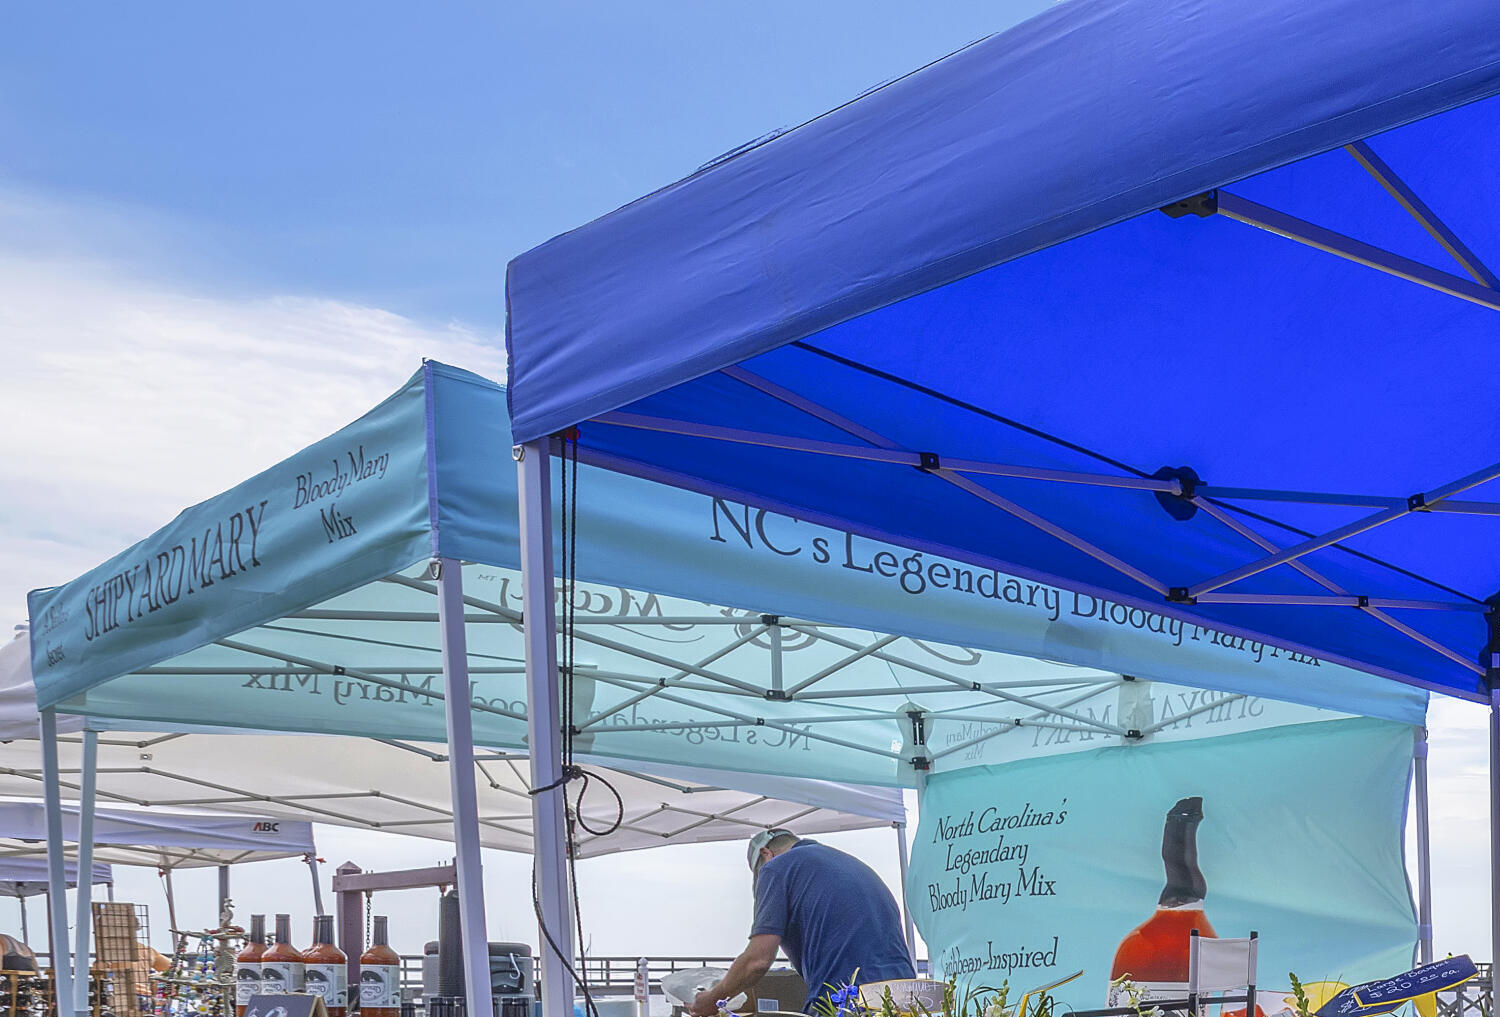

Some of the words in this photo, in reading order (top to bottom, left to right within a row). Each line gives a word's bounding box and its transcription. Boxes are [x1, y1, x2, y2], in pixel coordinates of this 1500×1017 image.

[293, 459, 348, 510] Bloody
[346, 445, 389, 486] Mary
[320, 503, 357, 544] Mix
[85, 545, 185, 641] SHIPYARD
[187, 500, 269, 594] MARY
[710, 496, 830, 564] NCs
[842, 532, 1061, 621] Legendary
[252, 821, 280, 833] ABC
[933, 813, 974, 844] North
[977, 797, 1068, 831] Carolina's
[945, 834, 1029, 873] Legendary
[928, 877, 968, 913] Bloody
[969, 875, 1012, 906] Mary
[1016, 867, 1056, 897] Mix
[1367, 976, 1404, 994] Large
